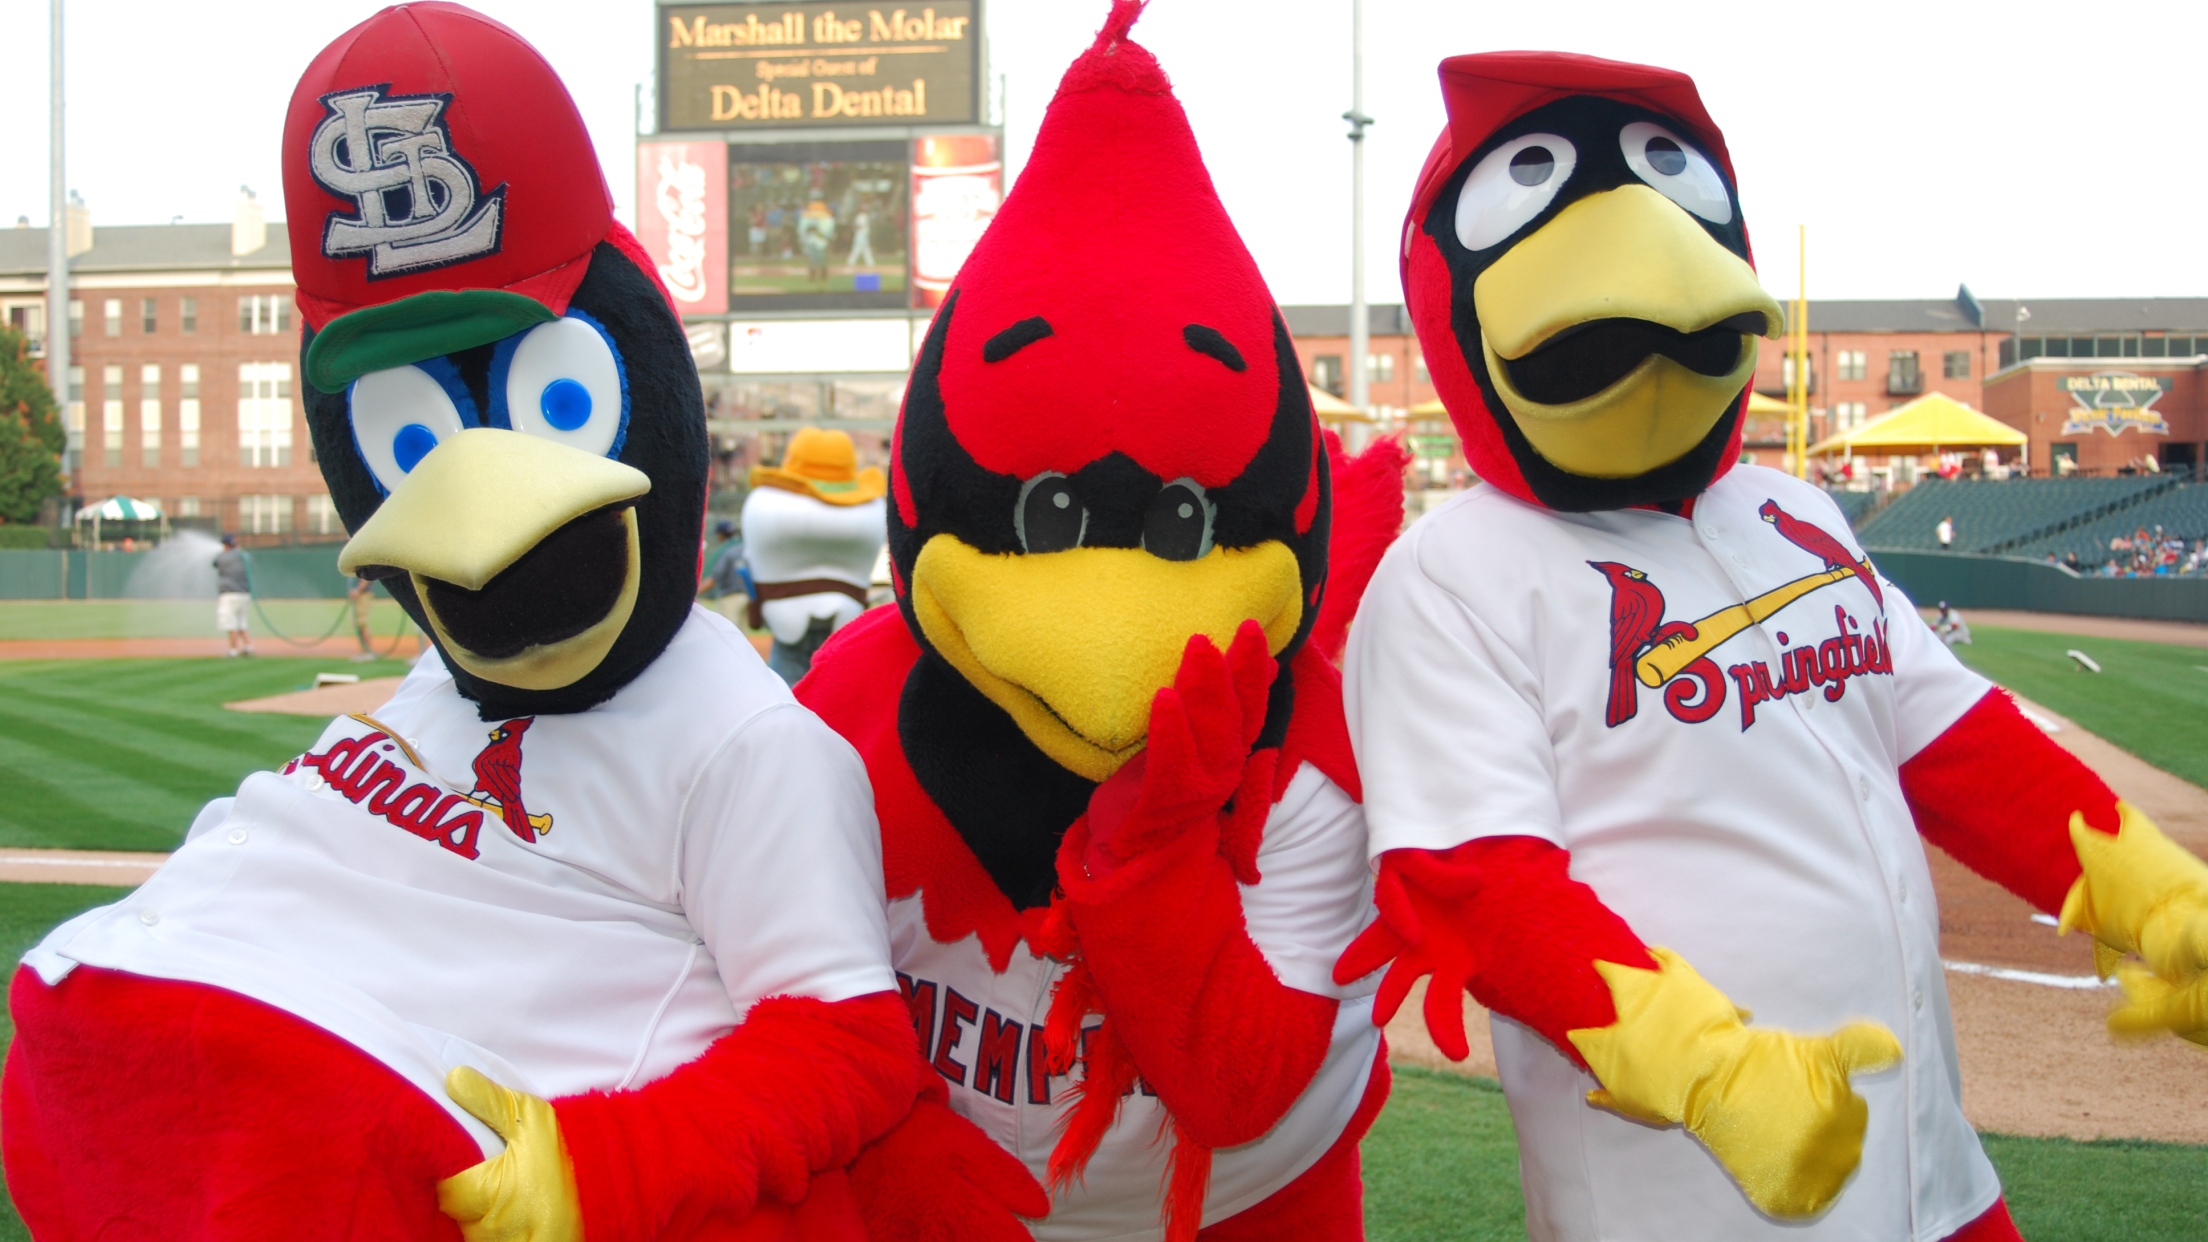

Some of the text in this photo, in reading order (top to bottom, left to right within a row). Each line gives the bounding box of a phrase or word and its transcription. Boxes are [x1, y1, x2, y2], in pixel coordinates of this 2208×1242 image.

[669, 8, 969, 48] Marshall the Molar
[755, 56, 879, 82] Special Guest of
[710, 78, 927, 121] Delta Dental
[2067, 376, 2161, 392] DELTA DENTAL
